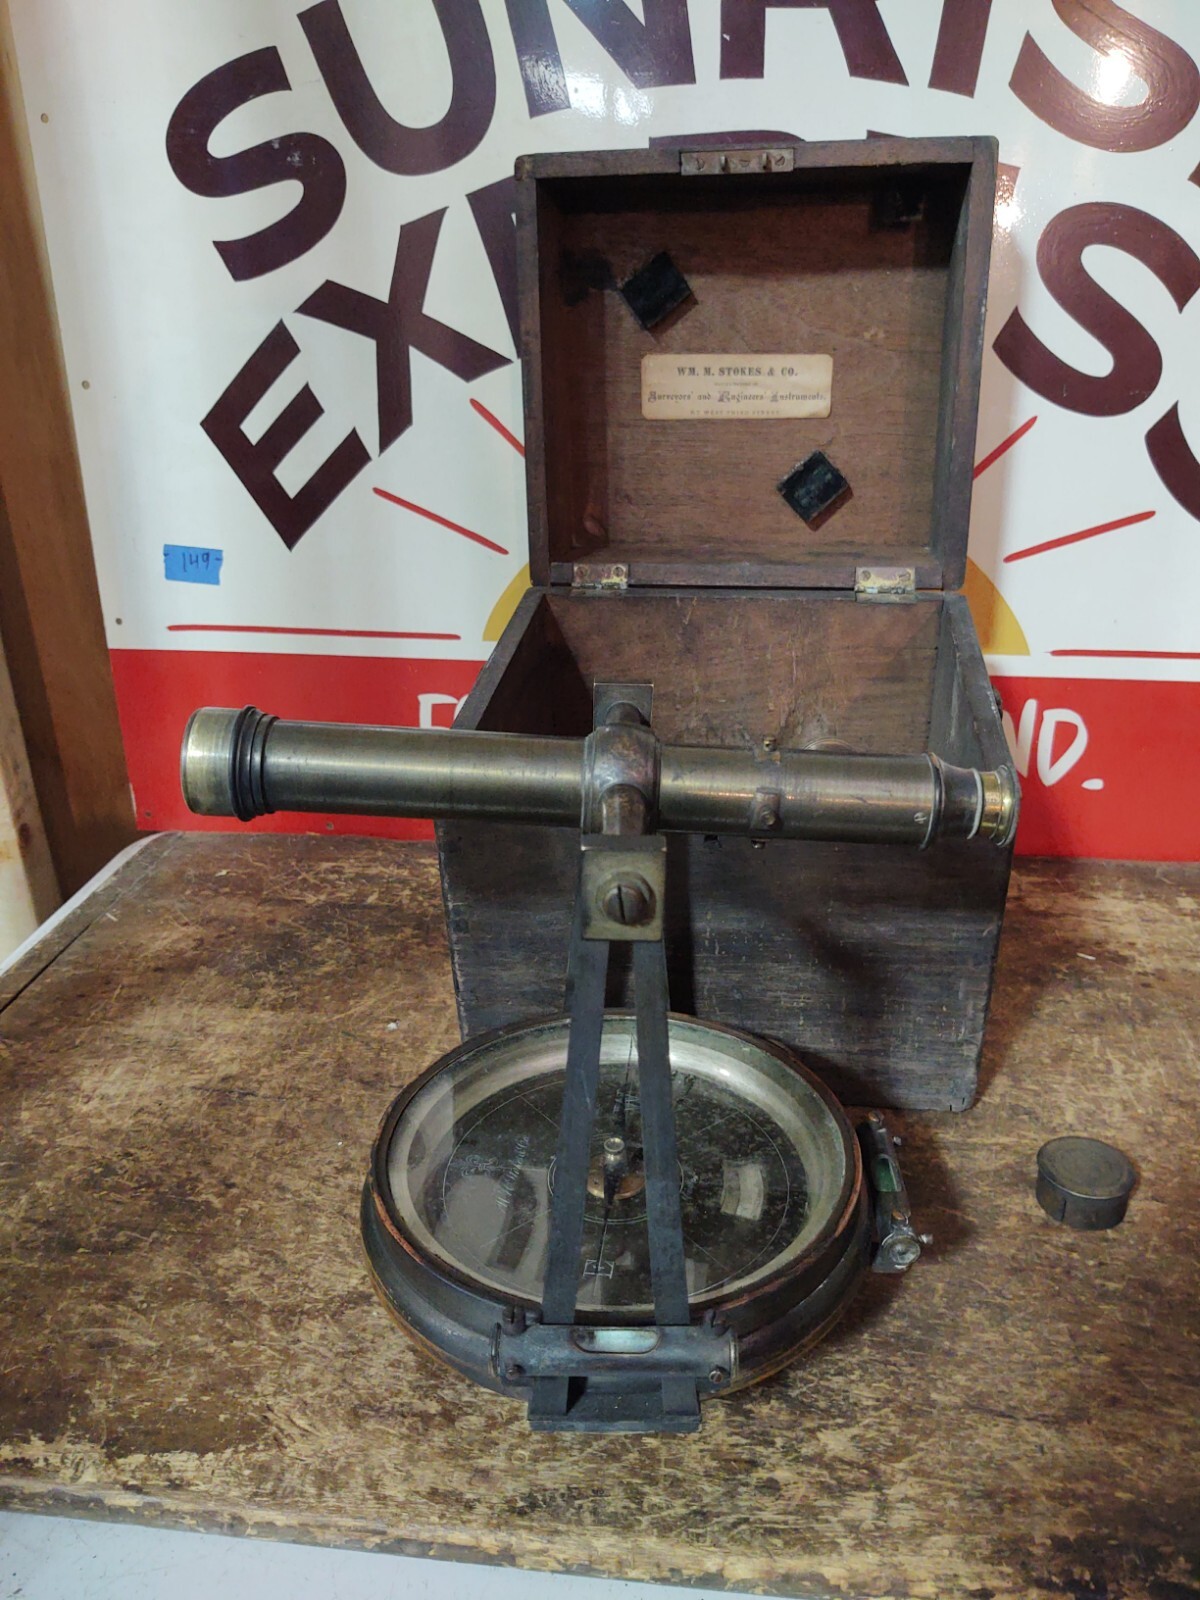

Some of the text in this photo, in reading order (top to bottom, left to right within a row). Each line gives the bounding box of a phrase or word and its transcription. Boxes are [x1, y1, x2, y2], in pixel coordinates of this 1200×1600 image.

[717, 366, 762, 377] STOKES
[766, 366, 775, 377] &
[780, 366, 799, 377] CO.
[697, 391, 712, 401] and
[182, 551, 210, 572] 149
